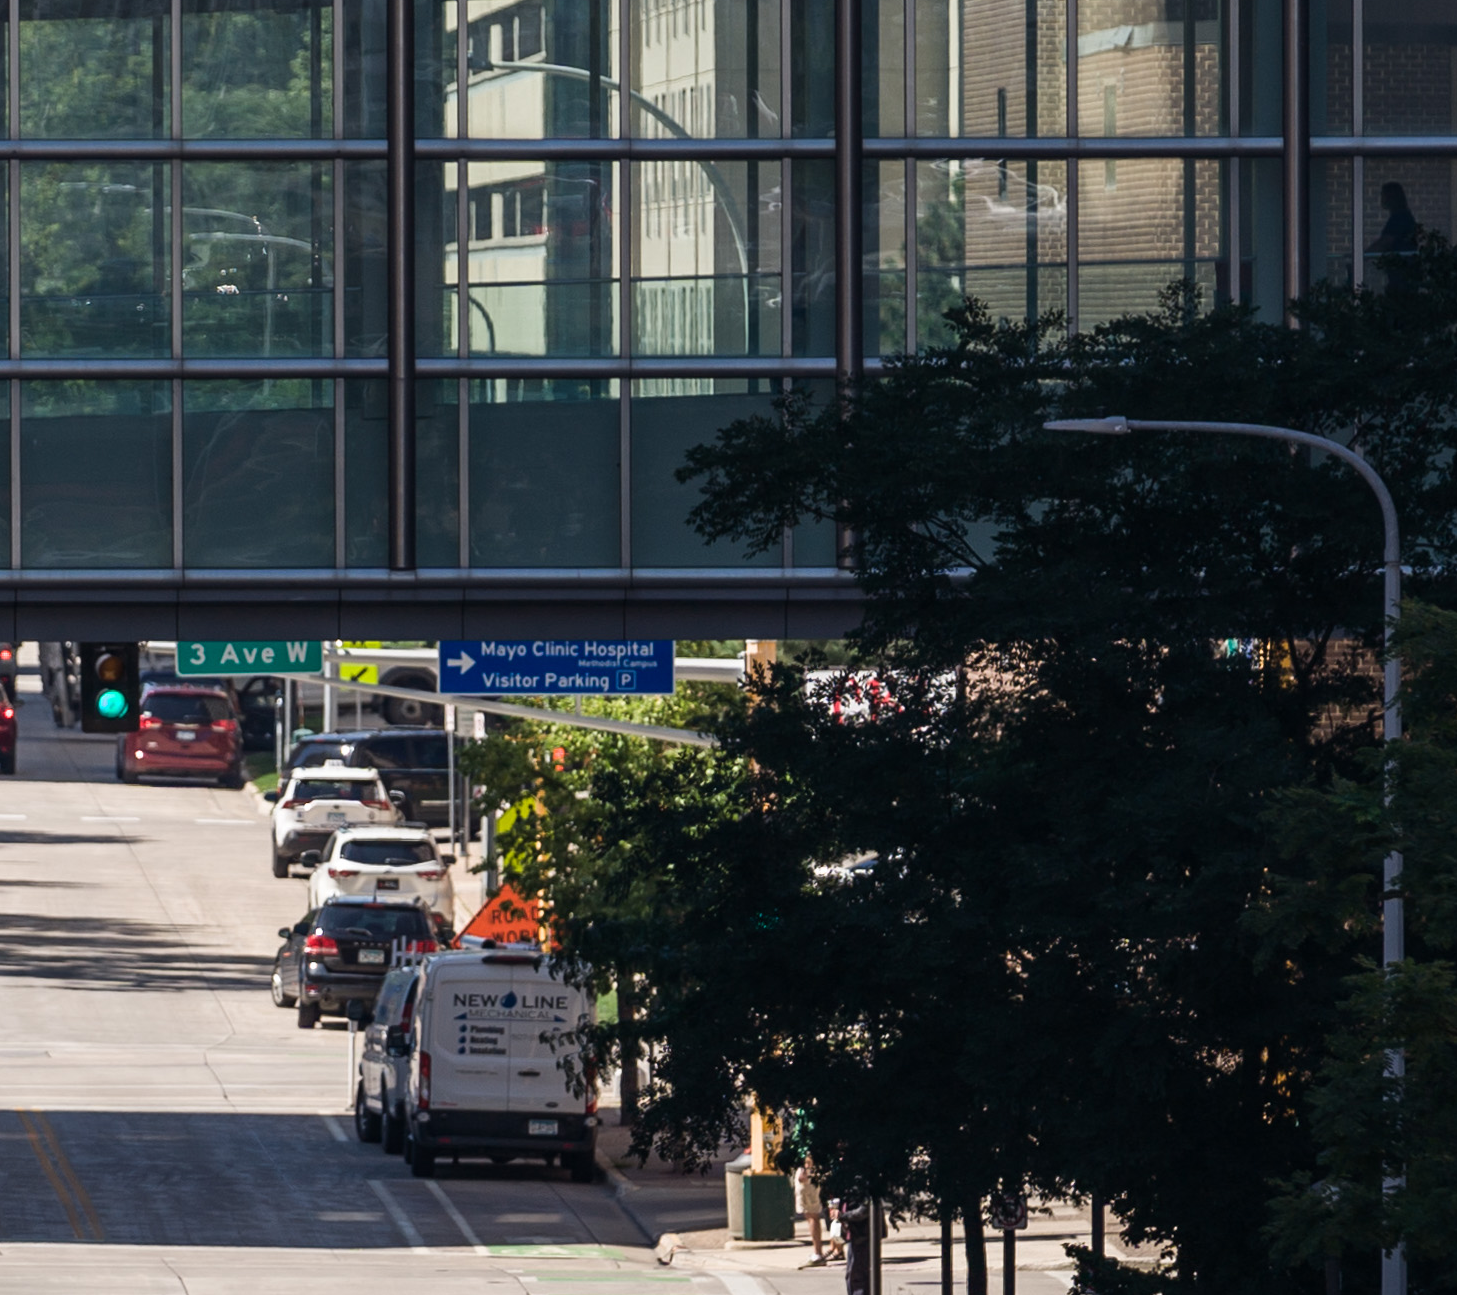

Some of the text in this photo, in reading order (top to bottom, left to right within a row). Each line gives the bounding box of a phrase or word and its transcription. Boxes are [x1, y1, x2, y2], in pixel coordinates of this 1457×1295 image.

[190, 641, 308, 665] 3 Ave W
[481, 640, 654, 662] Mayo Clinic Hospital
[623, 658, 658, 668] Campus
[482, 672, 632, 691] Visitor Parking P
[453, 993, 568, 1010] NEW LINE
[469, 1008, 551, 1019] MECHANICAL
